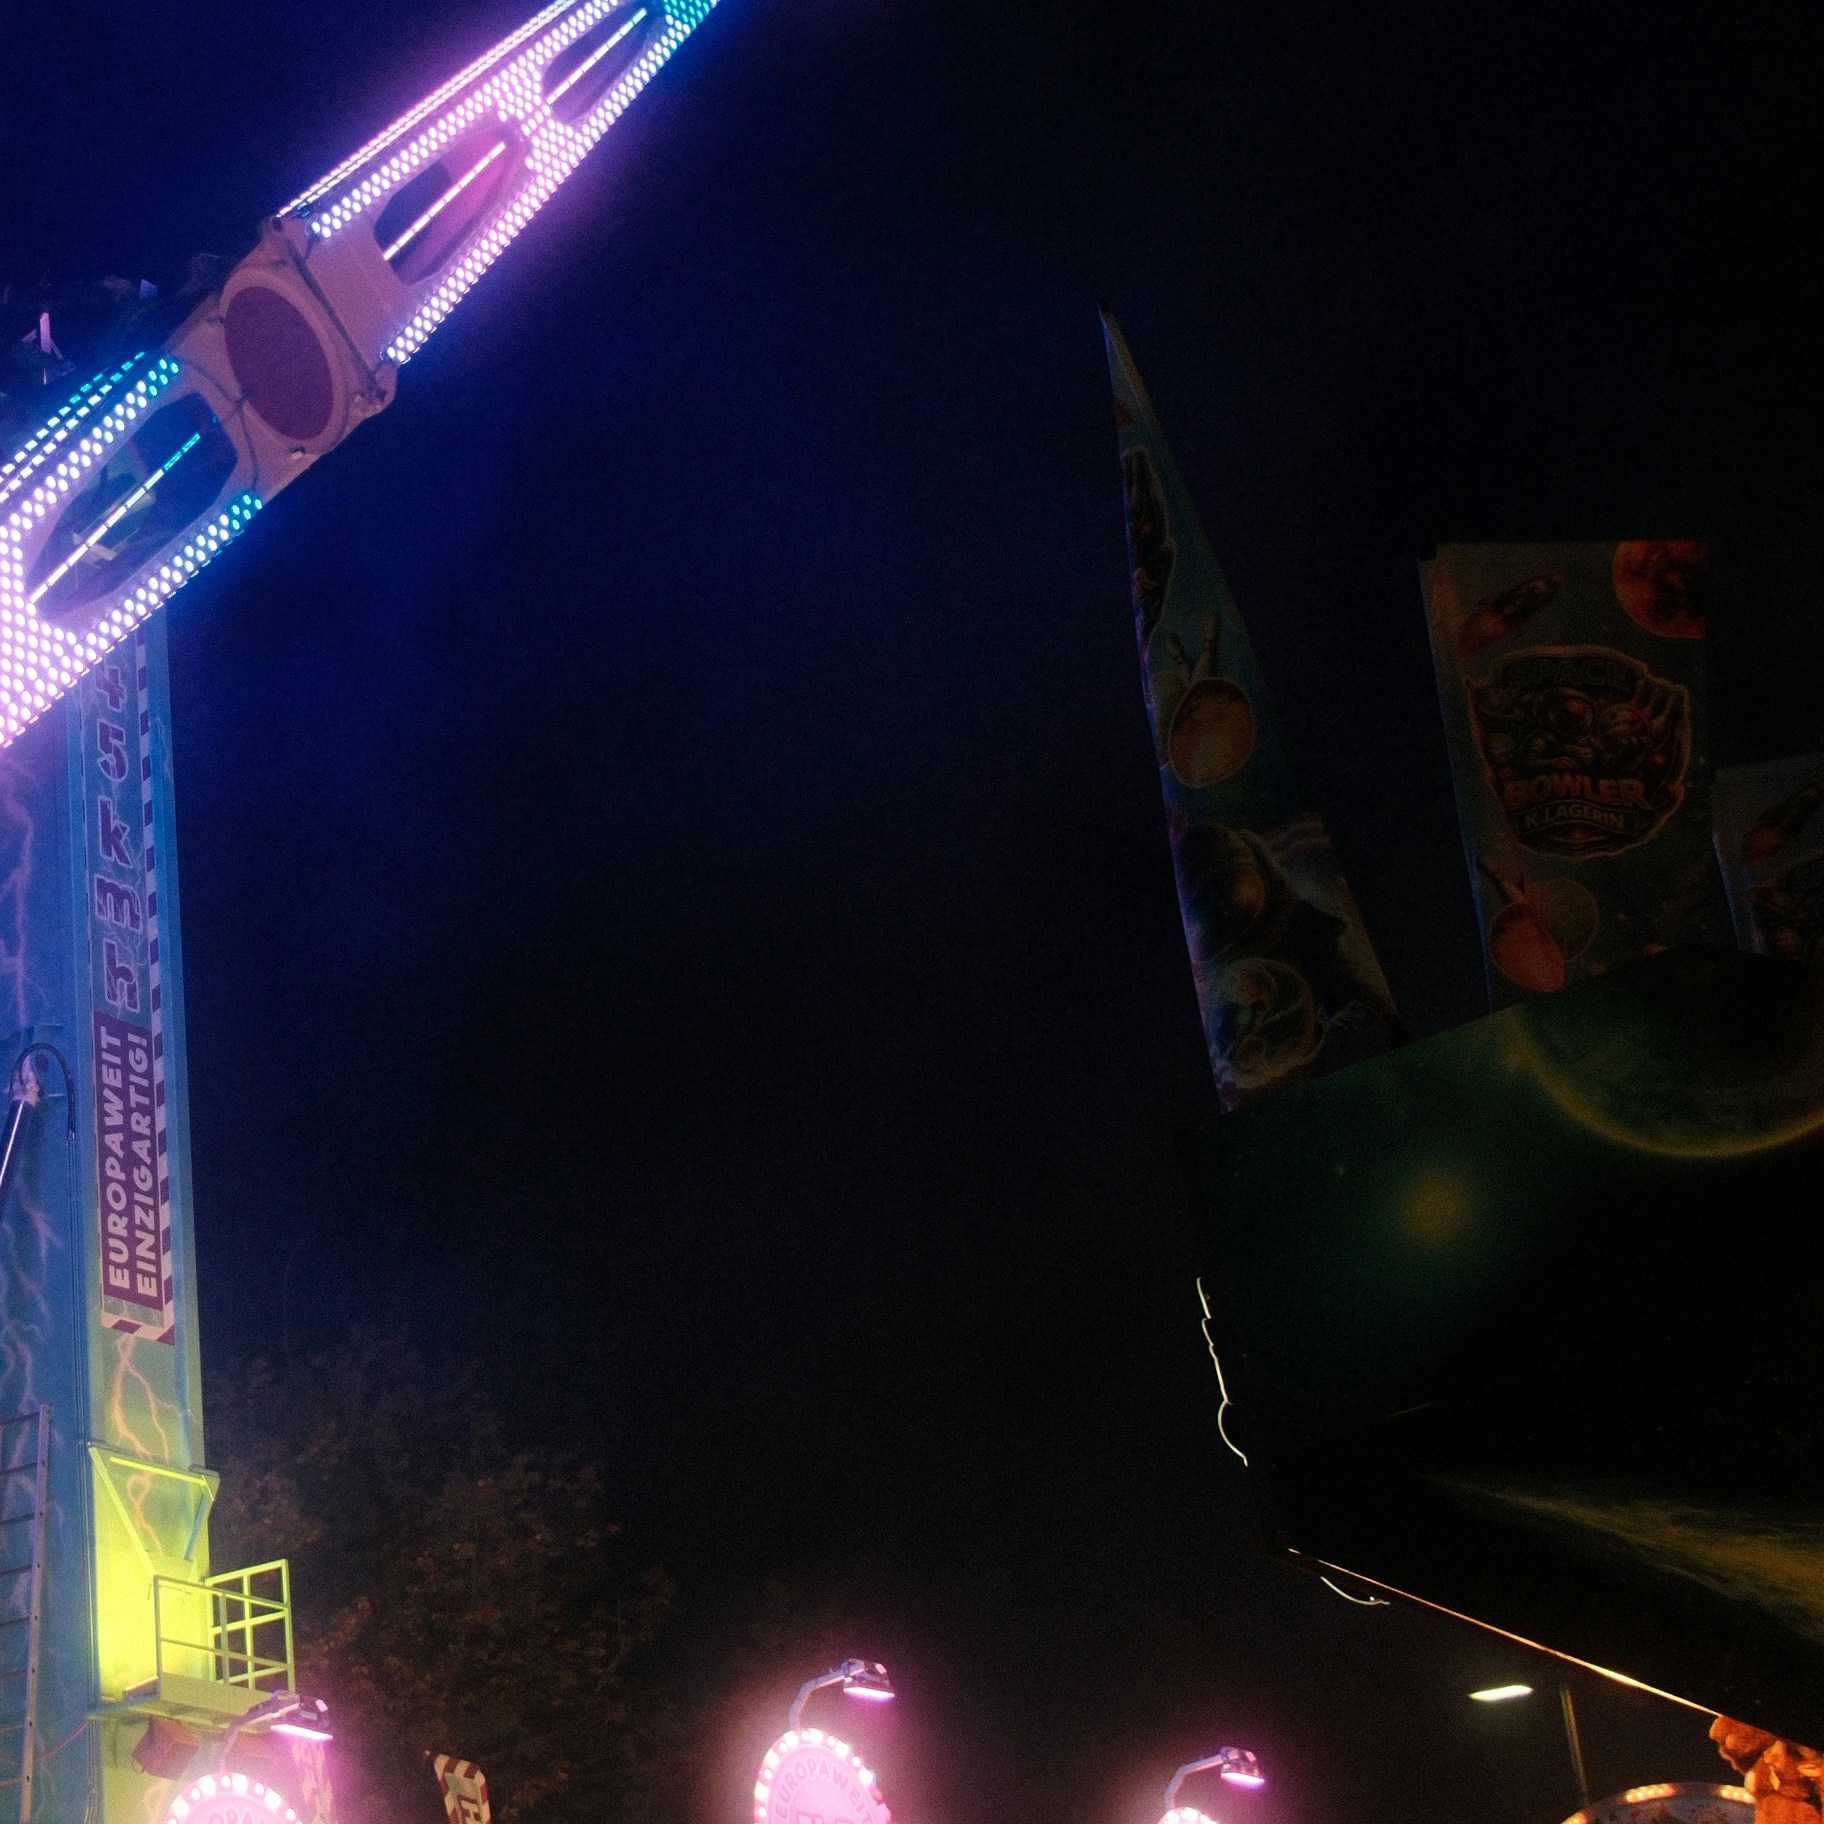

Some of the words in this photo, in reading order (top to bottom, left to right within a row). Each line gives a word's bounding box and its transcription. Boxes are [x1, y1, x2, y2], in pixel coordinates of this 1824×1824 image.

[1502, 771, 1654, 813] BOWLER
[100, 1025, 131, 1292] EUROPAWEIT
[127, 1032, 159, 1299] EINZIGARTIG!
